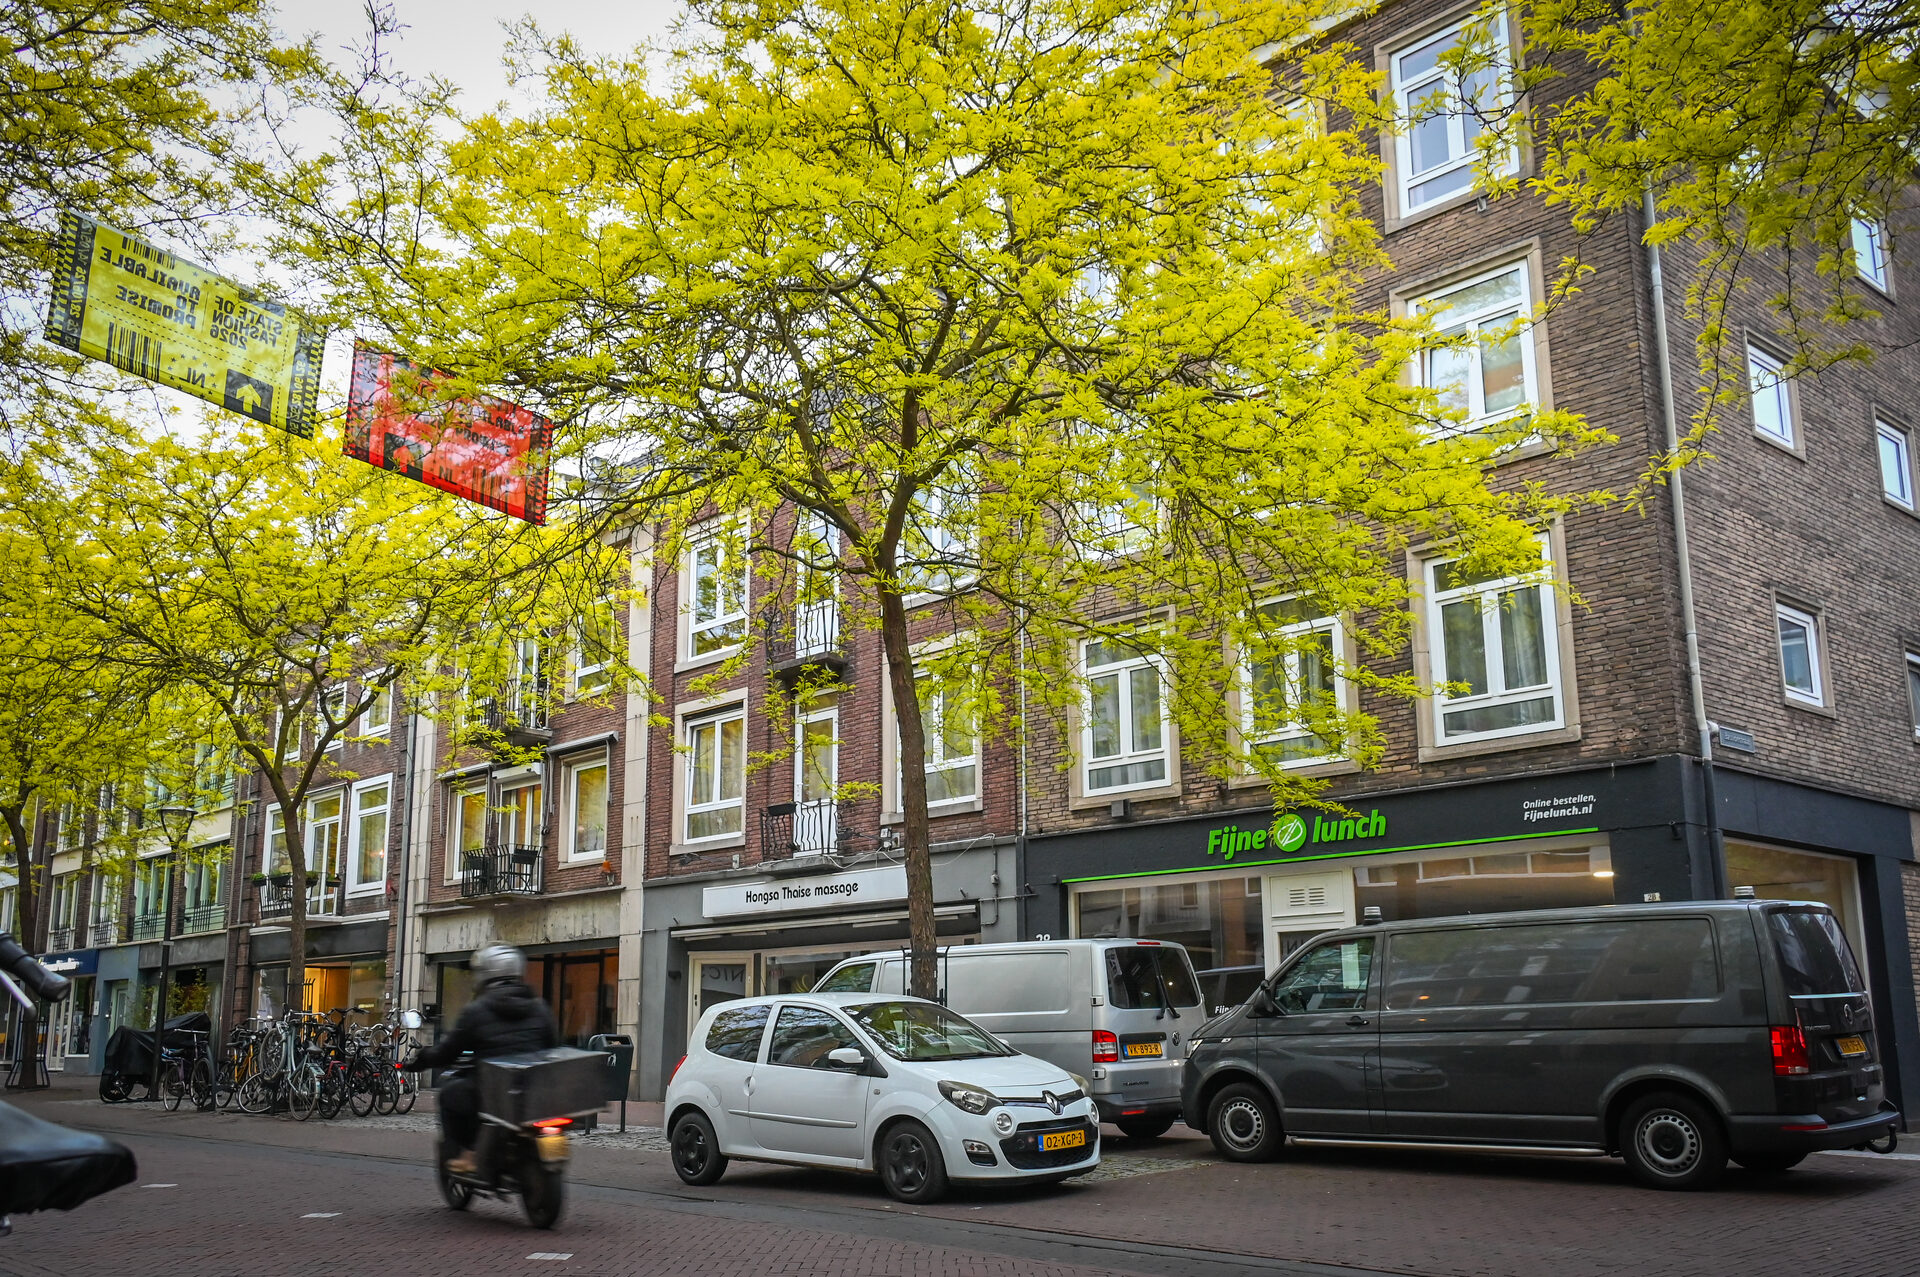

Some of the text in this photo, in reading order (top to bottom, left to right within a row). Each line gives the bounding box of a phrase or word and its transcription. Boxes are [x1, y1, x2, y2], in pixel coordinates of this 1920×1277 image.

[1523, 794, 1597, 809] Online bestellen,
[1523, 803, 1593, 822] Fijnelunch.nl
[1207, 809, 1387, 860] Fijne lunch
[745, 882, 859, 905] Hongsa Thaise massage
[1128, 1043, 1160, 1055] VK-893-R
[1046, 1132, 1083, 1148] 02-XGP-3
